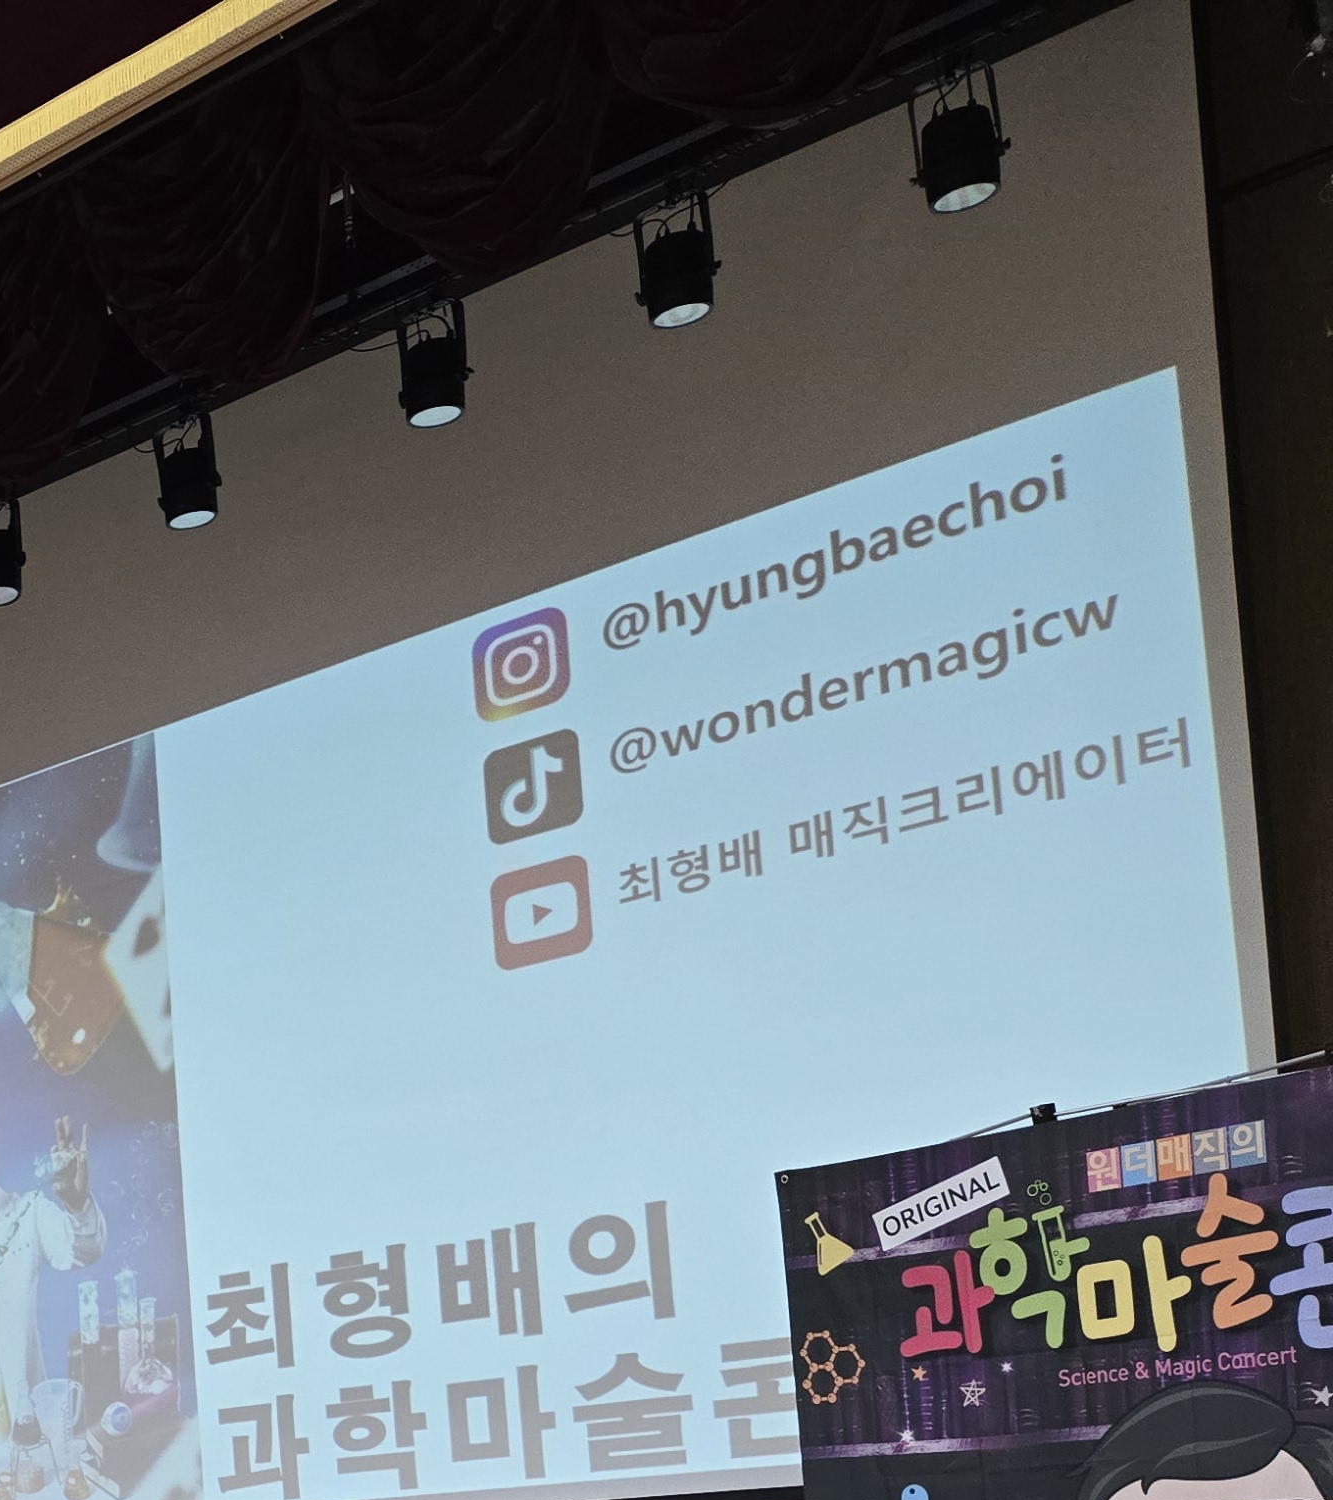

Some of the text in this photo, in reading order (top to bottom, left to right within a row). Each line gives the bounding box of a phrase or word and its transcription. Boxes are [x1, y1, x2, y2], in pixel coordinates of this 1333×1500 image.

[602, 454, 1068, 650] @hyungbaechoi
[610, 594, 1119, 774] @wondermagicw
[619, 717, 1192, 905] 최형배 매직크리에이터
[882, 1170, 1001, 1239] ORIGINAL
[1087, 1120, 1265, 1192] 원더매직의
[206, 1200, 676, 1368] 최형배의
[1059, 1346, 1297, 1388] Science & Magic Concert
